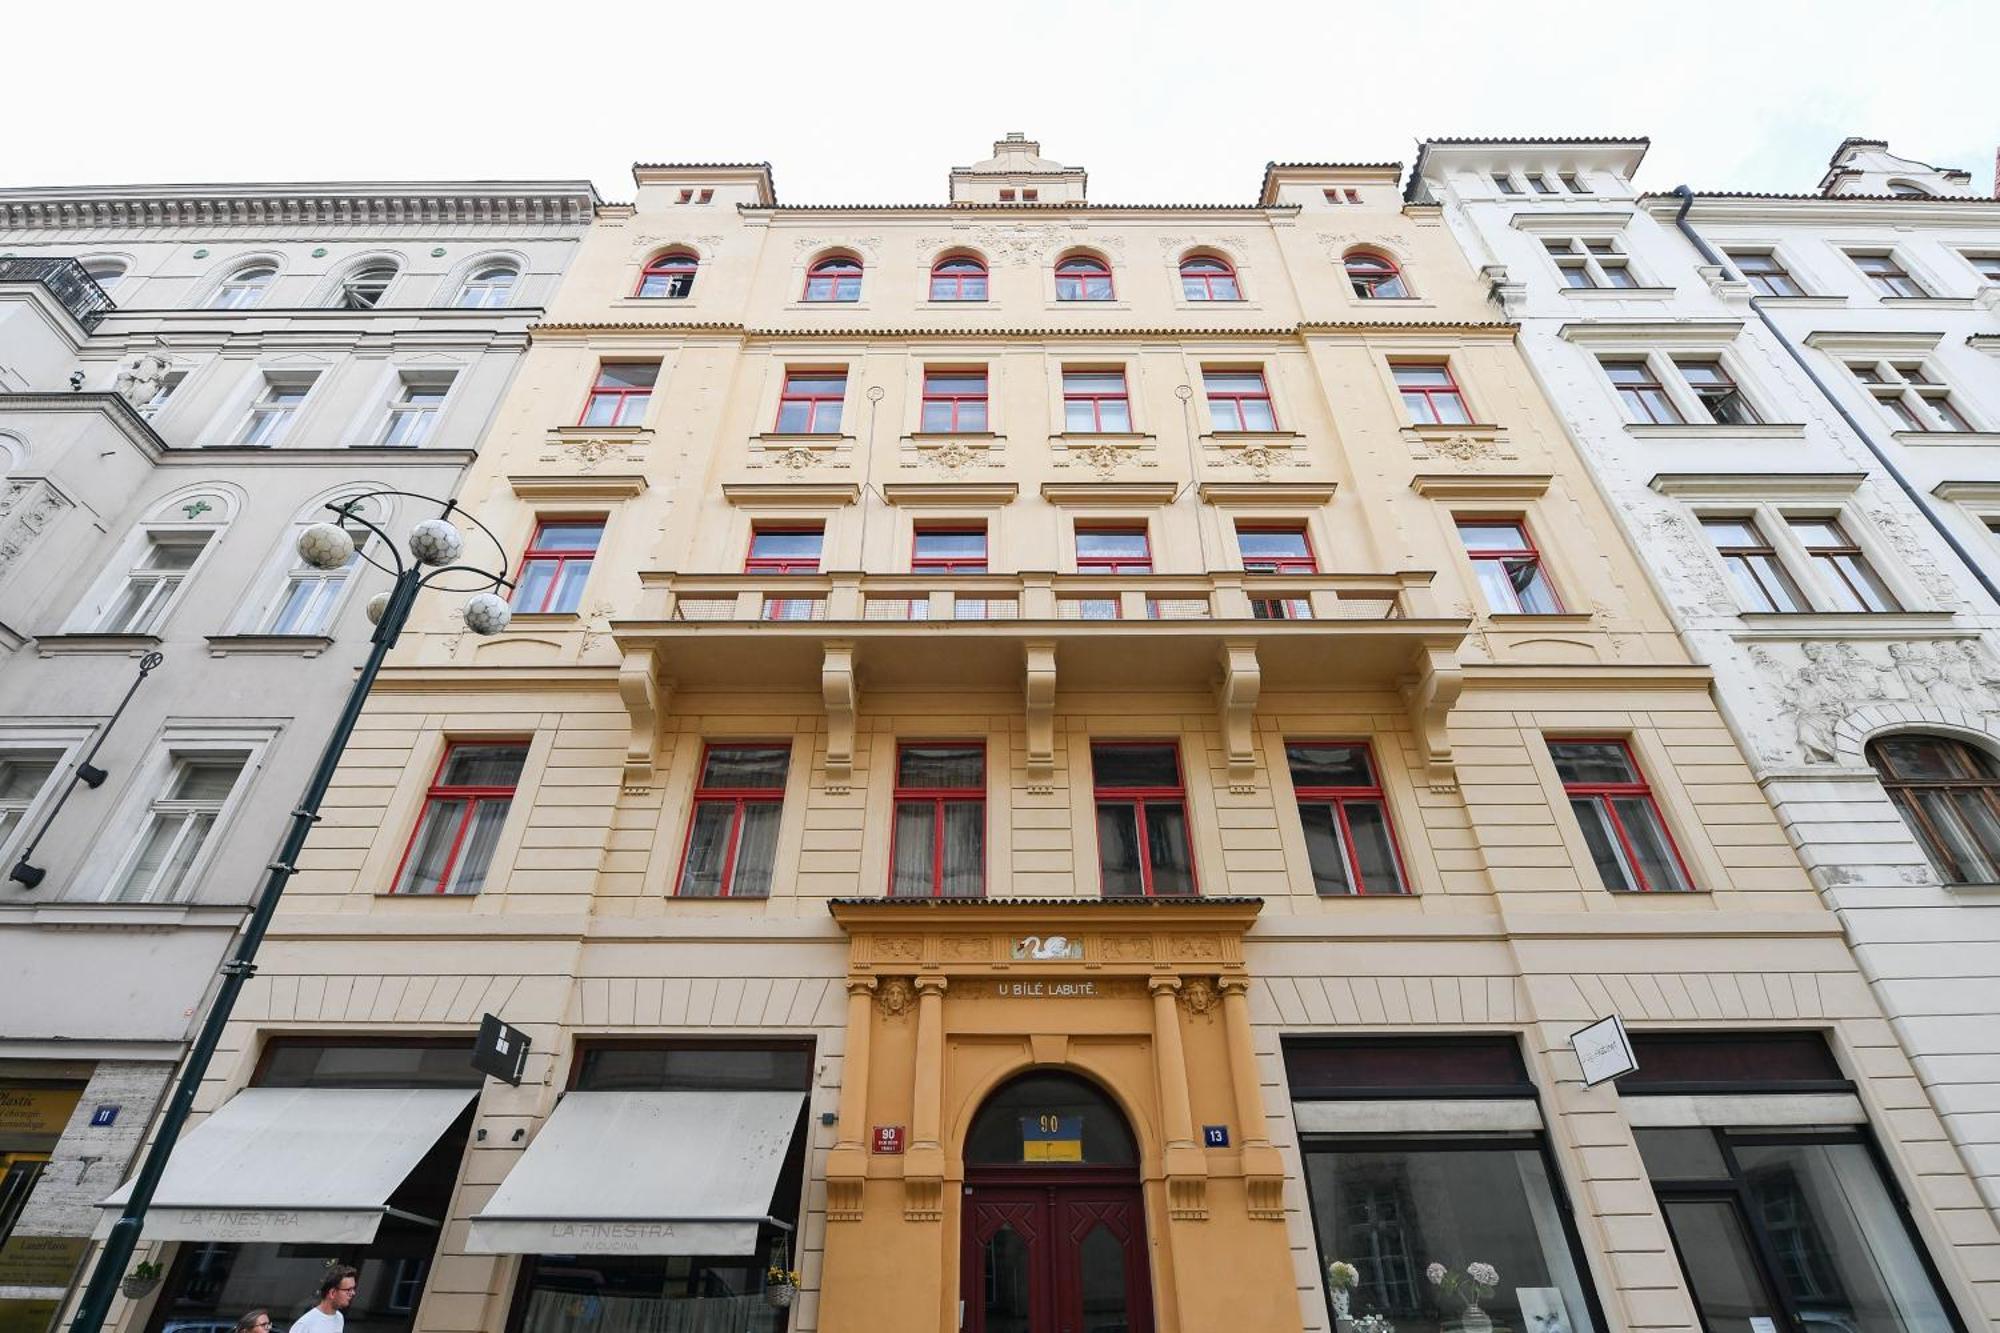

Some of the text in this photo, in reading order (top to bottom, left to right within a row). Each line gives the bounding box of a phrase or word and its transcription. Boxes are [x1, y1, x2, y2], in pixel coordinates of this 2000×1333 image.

[999, 983, 1008, 995] U
[99, 1110, 110, 1122] 11
[1040, 1114, 1058, 1133] 90
[882, 1128, 896, 1140] 90
[1210, 1130, 1222, 1142] 13
[179, 1211, 299, 1226] LA FINESTRA
[552, 1223, 675, 1238] LA FINESTRA
